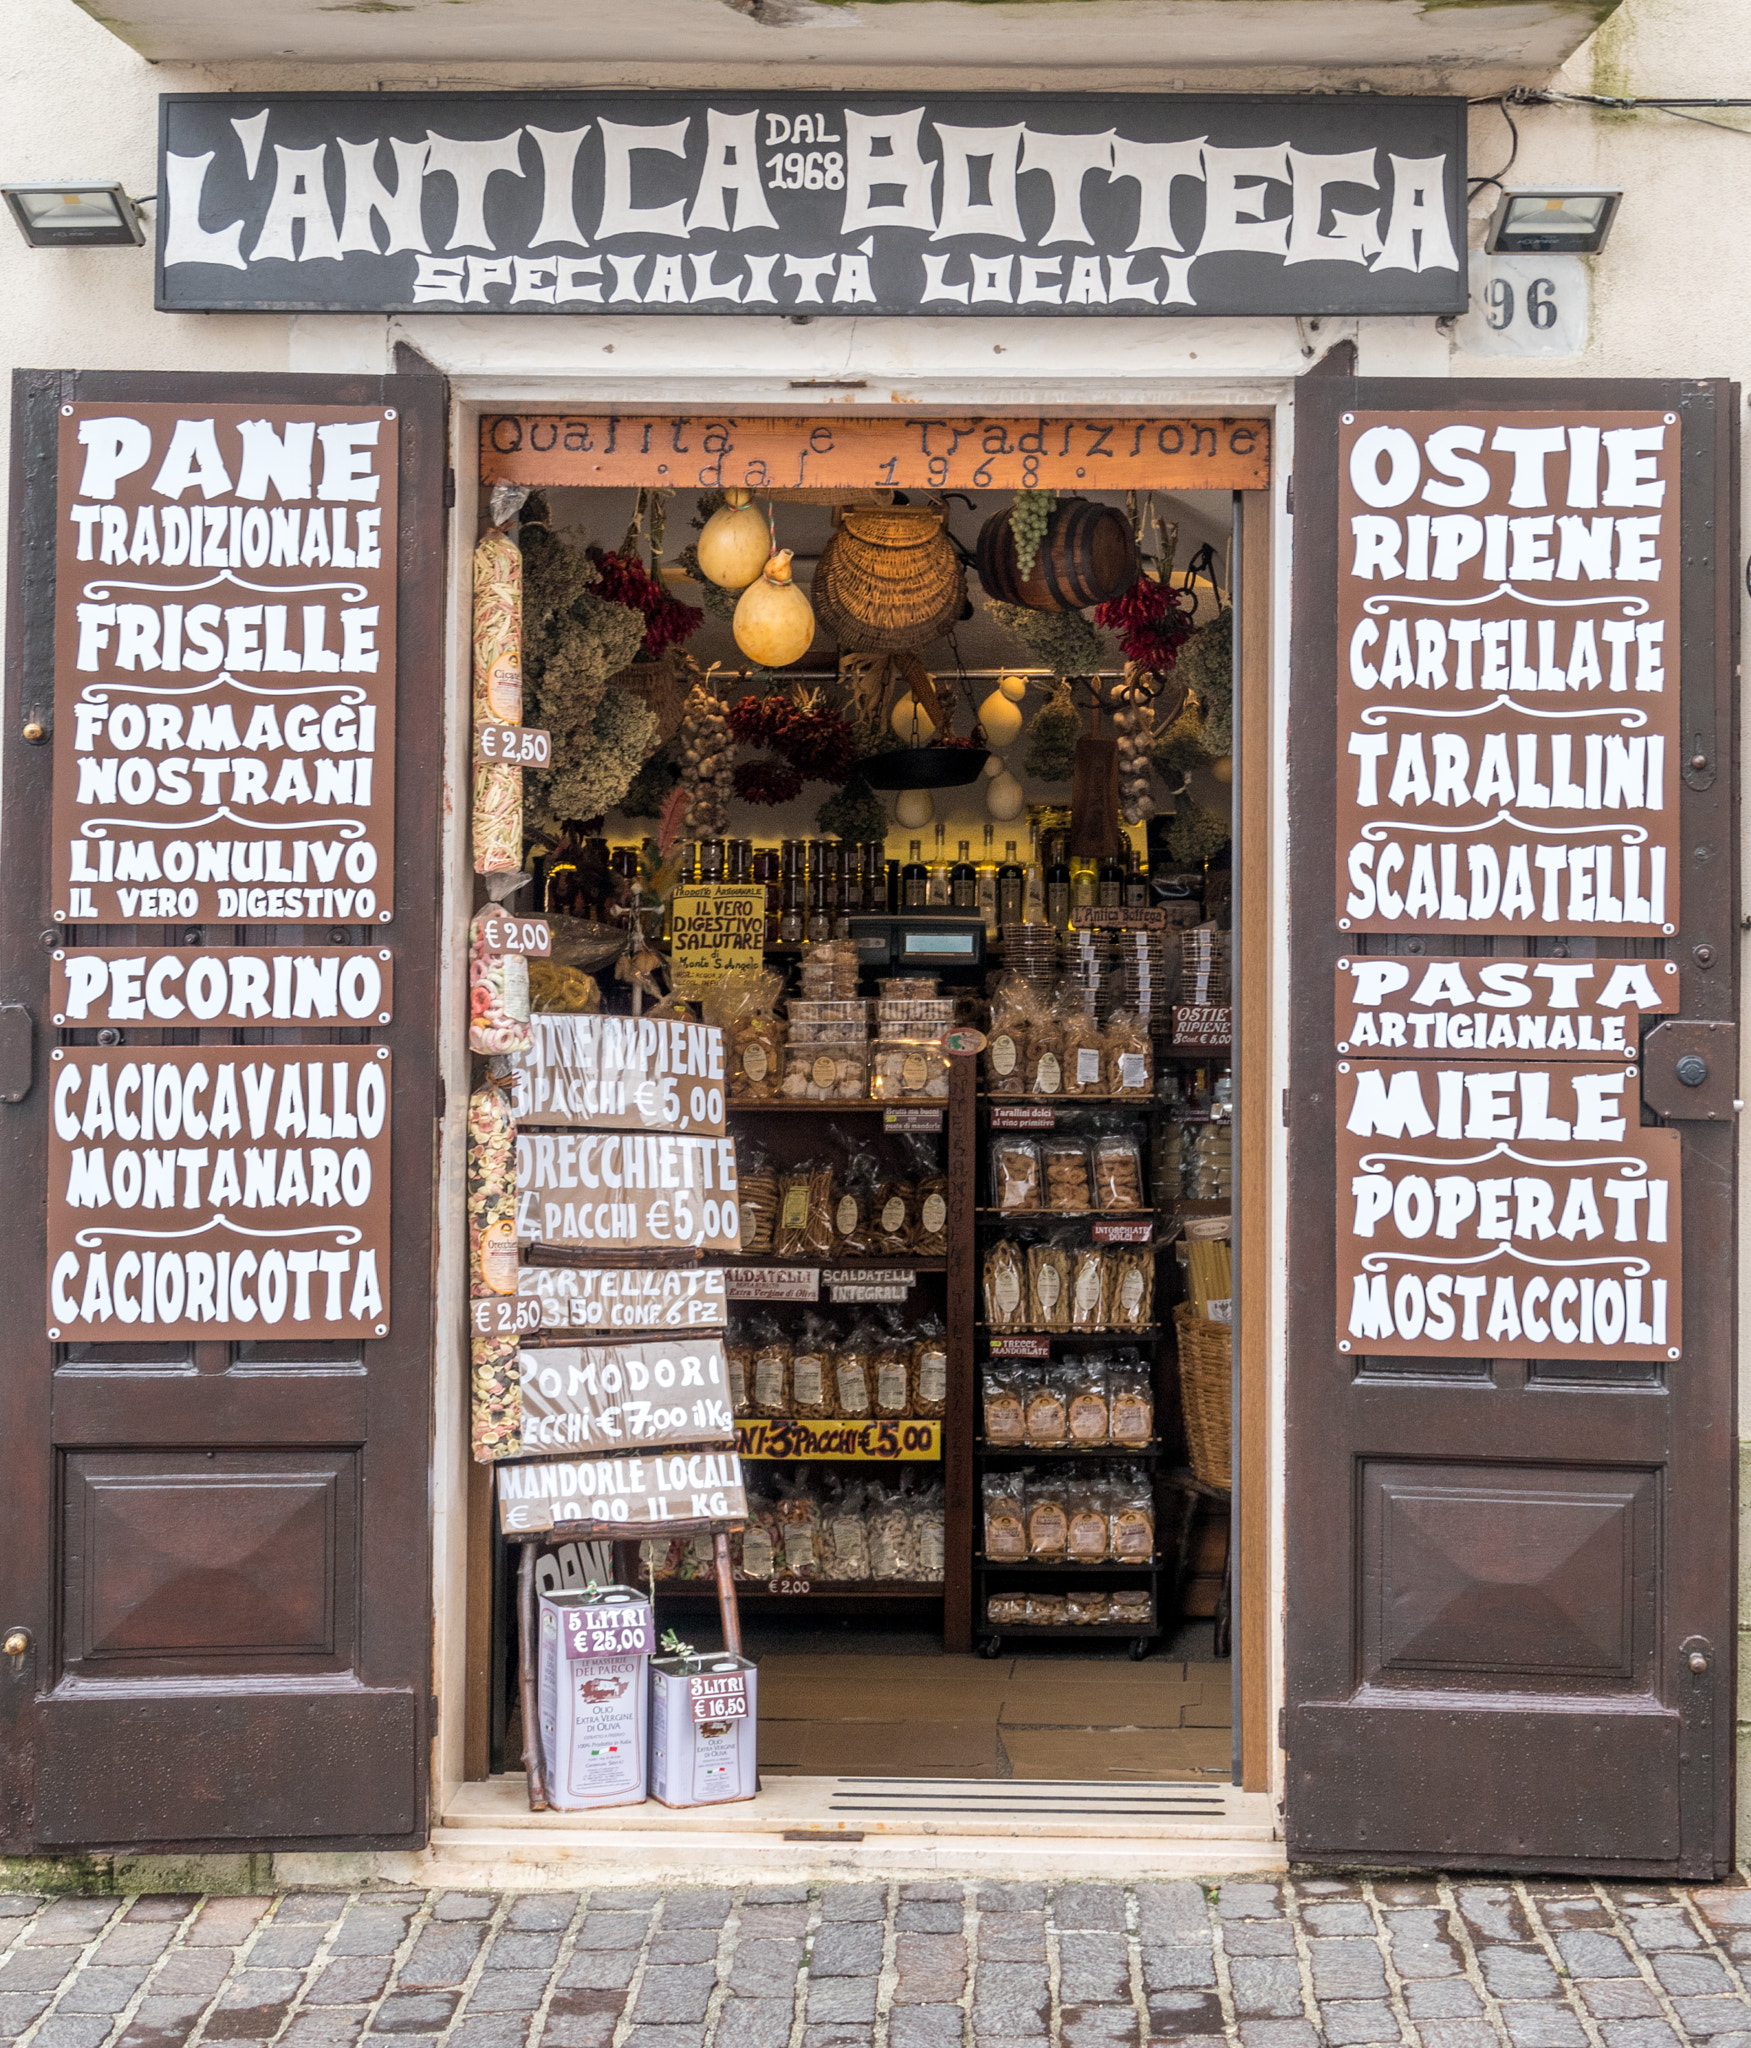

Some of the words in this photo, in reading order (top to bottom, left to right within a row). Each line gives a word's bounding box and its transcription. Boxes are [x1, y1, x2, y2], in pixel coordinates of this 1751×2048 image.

[765, 113, 841, 145] DAL
[165, 108, 780, 270] L'ANTICA
[841, 106, 1459, 272] BOTTEGA
[765, 152, 846, 191] 1968
[920, 252, 1200, 306] LOCALI
[1484, 278, 1558, 330] 96
[808, 426, 835, 453] e
[904, 418, 1258, 458] Tradizione
[78, 417, 380, 502] PANE
[698, 450, 808, 489] dal
[874, 455, 1039, 489] 1968
[1350, 425, 1666, 508] OSTIE
[71, 505, 382, 568] TRADIZIONALE
[1351, 514, 1662, 581] RIPIENE
[77, 603, 380, 673] FRISELLE
[1350, 618, 1665, 692] CARTELLATE
[75, 703, 377, 752] FORMAGGI
[481, 727, 497, 757] €
[501, 731, 548, 762] 2,50
[77, 757, 372, 806] NOSTRANI
[1348, 731, 1665, 811] TARALLINI
[70, 840, 377, 883] LIMONULIVO
[70, 887, 98, 917] IL
[117, 887, 198, 917] VERO
[218, 888, 376, 917] DIGESTIVO
[1346, 841, 1666, 925] SCALDATELLI
[673, 916, 763, 932] DIGESTIVO
[696, 901, 711, 916] IL
[714, 901, 753, 916] VERO
[485, 919, 501, 949] €
[503, 922, 549, 953] 2,00
[675, 933, 764, 950] SALUTARE
[711, 950, 719, 958] di
[65, 955, 382, 1020] PECORINO
[1351, 961, 1662, 1008] PASTA
[1176, 1022, 1231, 1033] RIPIENE
[1177, 1007, 1230, 1022] OSTIE
[1349, 1012, 1626, 1050] ARTIGIANALE
[602, 1016, 725, 1080] RIPIENE
[1200, 1034, 1208, 1044] €
[1209, 1034, 1231, 1045] 5,00
[54, 1061, 386, 1141] CACIOCAVALLO
[534, 1077, 625, 1116] PACCHI
[994, 1108, 1030, 1117] Tarallini
[1032, 1108, 1052, 1117] dolci
[1346, 1069, 1626, 1141] MIELE
[1019, 1119, 1055, 1129] primitivo
[66, 1146, 371, 1208] MONTANARO
[517, 1135, 737, 1191] ORECCHIETTE
[545, 1202, 637, 1239] PACCHI
[1352, 1174, 1668, 1242] POPERATI
[51, 1248, 383, 1324] CACIORICOTTA
[822, 1269, 914, 1283] SCALDATELLI
[833, 1286, 908, 1301] INTEGRALI
[475, 1302, 491, 1332] €
[496, 1300, 541, 1334] 2,50
[667, 1300, 682, 1325] 6
[688, 1300, 724, 1325] PZ.
[1348, 1273, 1667, 1345] MOSTACCIOLI
[1003, 1340, 1037, 1348] TRECCE
[521, 1406, 590, 1445] ECCHI
[792, 1425, 858, 1457] PACCHI
[500, 1458, 646, 1500] MANDORLE
[655, 1454, 743, 1492] LOCALI
[506, 1504, 530, 1529] €
[647, 1496, 674, 1521] IL
[769, 1579, 778, 1593] €
[781, 1580, 810, 1595] 2,00
[569, 1612, 582, 1631] 5
[586, 1608, 647, 1630] LITRI
[574, 1631, 588, 1653] €
[592, 1628, 645, 1653] 25,00
[575, 1668, 596, 1677] DEL
[598, 1664, 635, 1675] PARCO
[691, 1678, 703, 1696] 3
[703, 1676, 744, 1695] LITRI
[694, 1700, 706, 1717] €
[709, 1697, 746, 1718] 16,50
